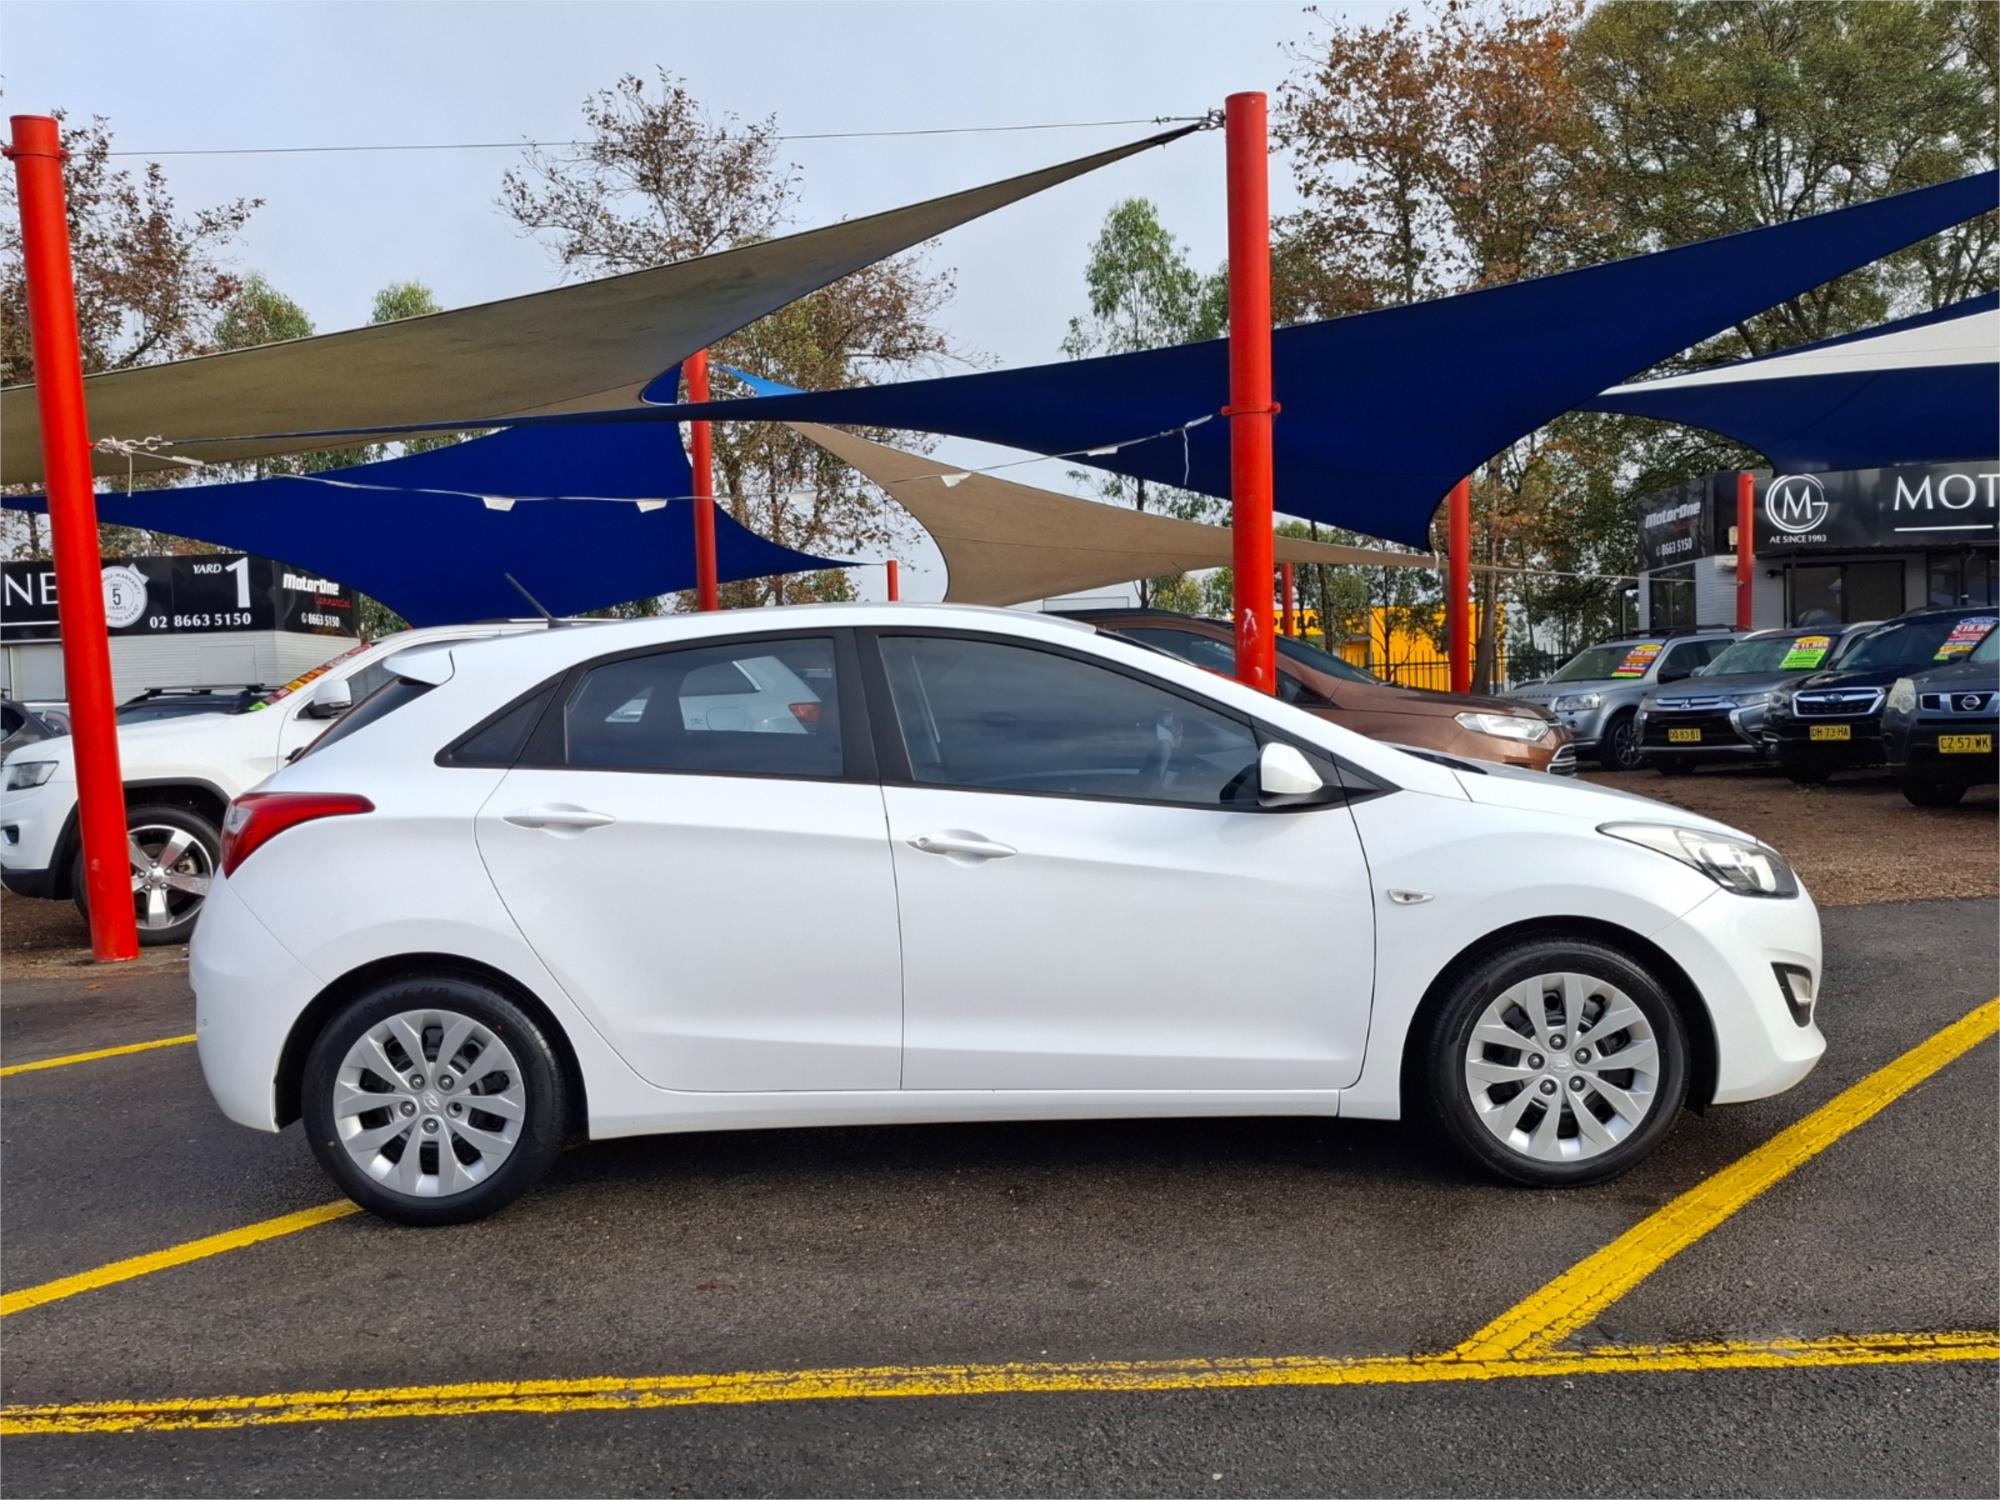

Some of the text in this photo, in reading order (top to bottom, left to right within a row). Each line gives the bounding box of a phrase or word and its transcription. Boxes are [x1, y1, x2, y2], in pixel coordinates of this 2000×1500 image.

[1894, 473, 2000, 511] MOT
[1782, 534, 1807, 544] SINCE
[1808, 534, 1828, 543] 1993
[193, 563, 222, 575] YARD
[4, 572, 59, 606] NE
[224, 556, 251, 608] 1
[282, 573, 340, 596] MotorOne
[112, 588, 121, 606] 5
[149, 612, 252, 629] 02 8663 5150
[308, 613, 341, 628] 8663 5150
